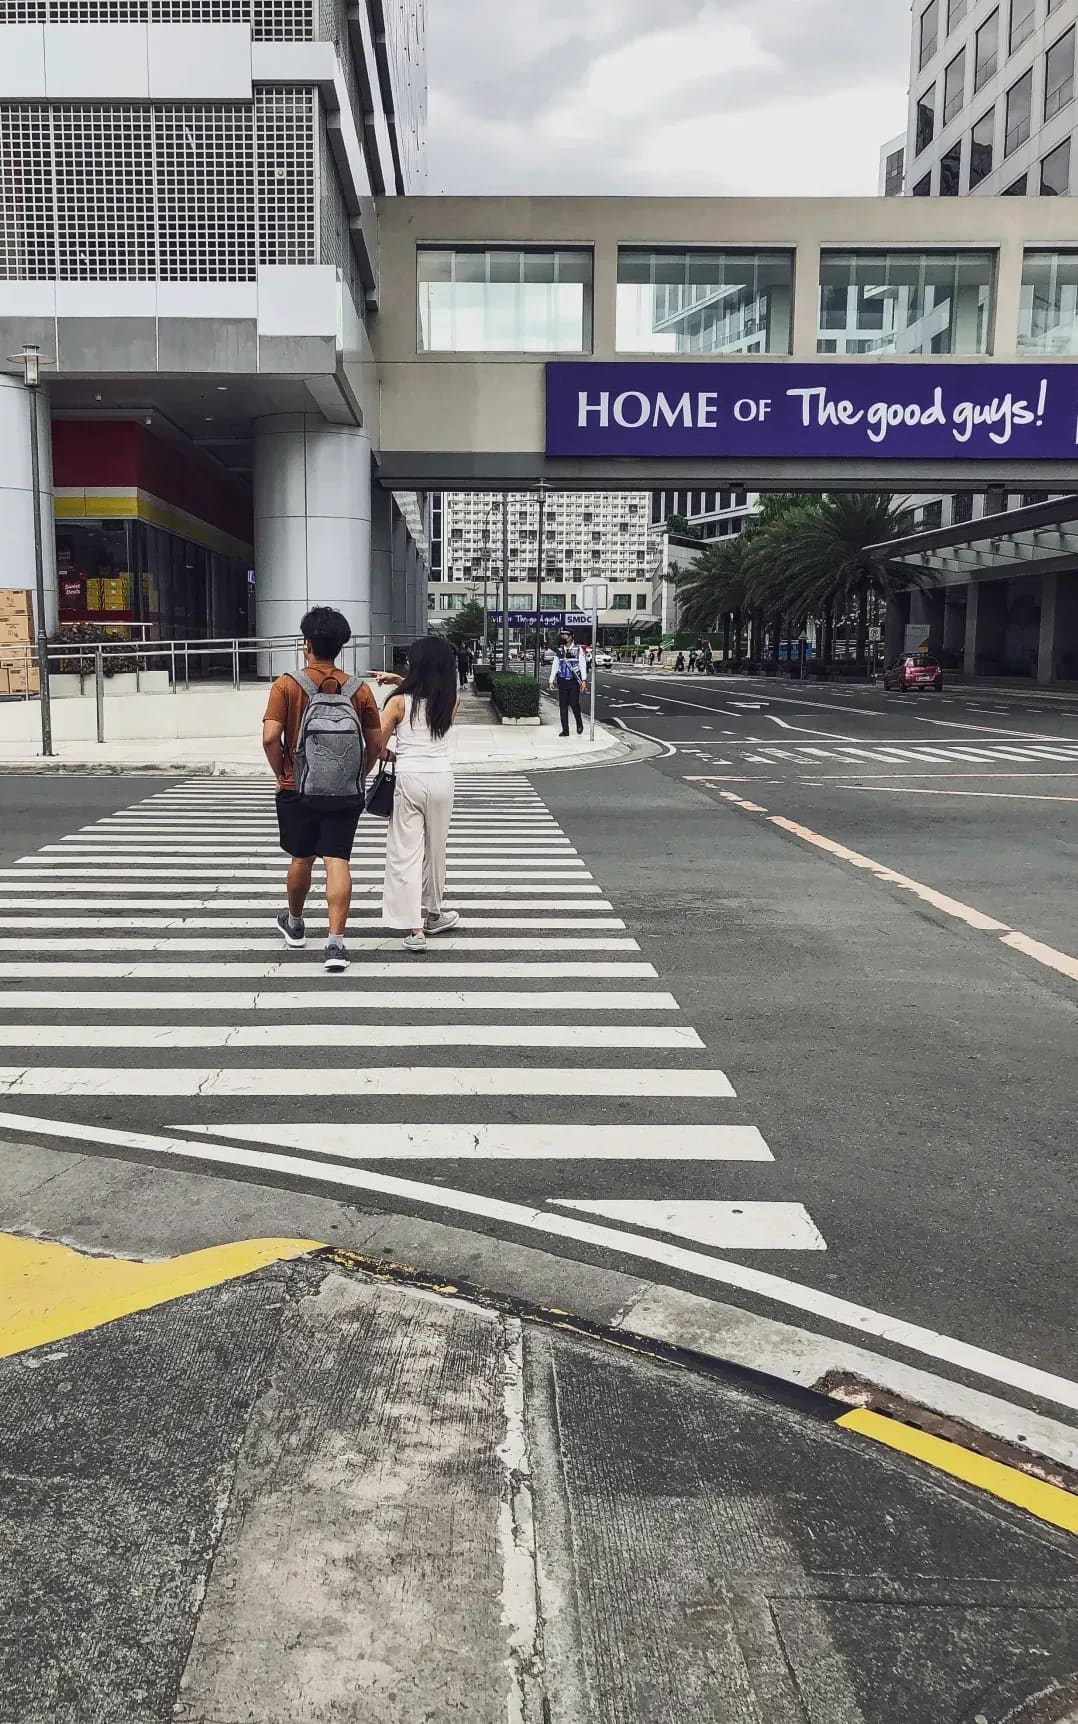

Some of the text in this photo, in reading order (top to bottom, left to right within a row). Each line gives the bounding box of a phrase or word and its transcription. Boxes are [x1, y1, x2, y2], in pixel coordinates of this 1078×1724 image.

[577, 378, 1048, 444] HOME OF The good guys!
[567, 615, 593, 623] SMDC
